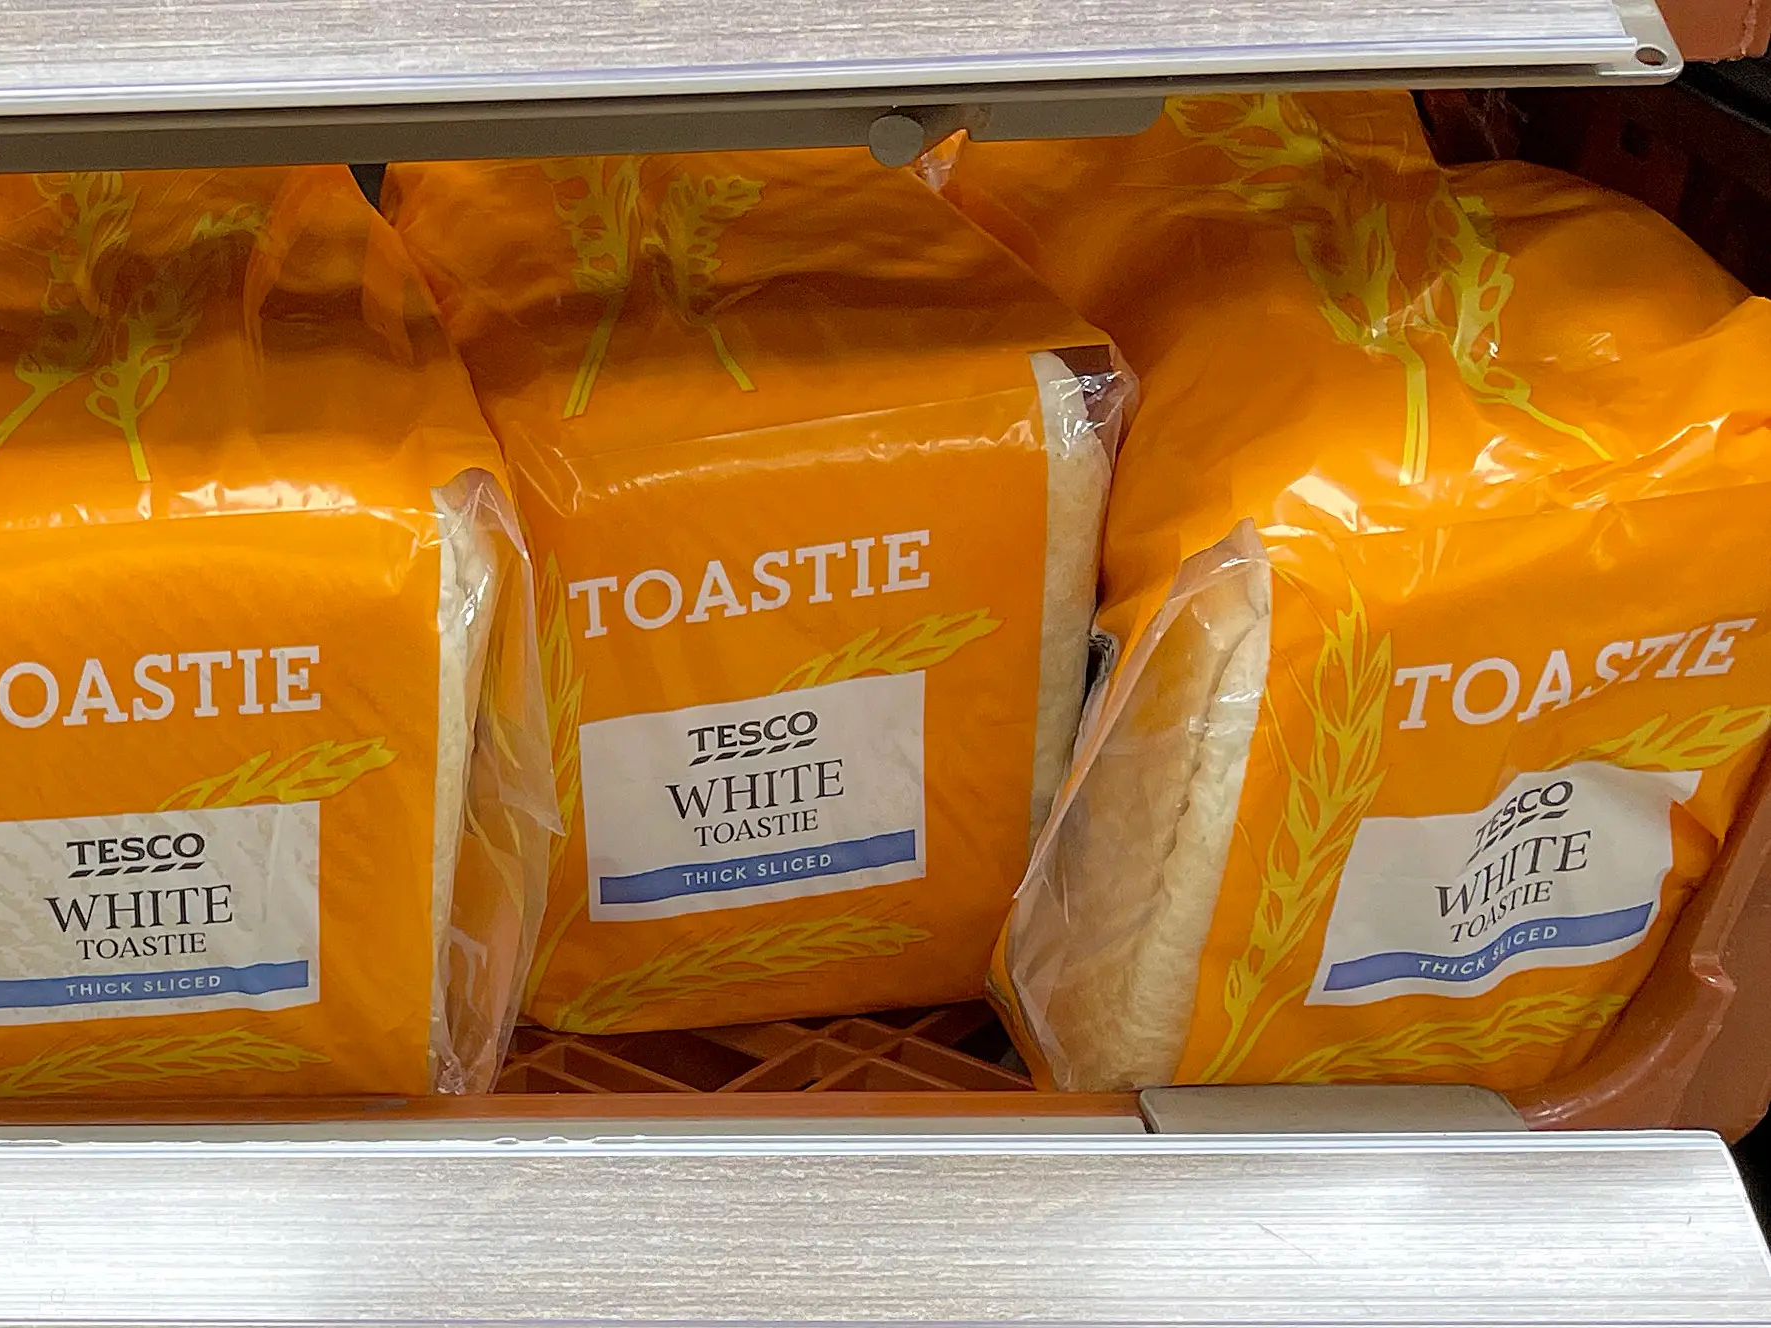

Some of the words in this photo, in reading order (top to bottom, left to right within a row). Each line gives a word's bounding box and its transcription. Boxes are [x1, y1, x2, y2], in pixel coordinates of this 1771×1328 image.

[568, 529, 931, 640] TOASTIE
[1393, 617, 1758, 731] TOASTIE
[687, 709, 820, 753] TESCO
[664, 758, 845, 821] WHITE
[1476, 779, 1574, 847] TESCO
[65, 832, 206, 867] TESCO
[693, 808, 820, 848] TOASTIE
[682, 865, 749, 887] THICK
[756, 853, 833, 878] SLICED
[1434, 829, 1593, 918] WHITE
[43, 884, 234, 934] WHITE
[1449, 879, 1554, 944] TOASTIE
[75, 932, 208, 961] TOASTIE
[1417, 956, 1488, 976] THICK
[1492, 925, 1559, 963] SLICED
[65, 980, 134, 998] THICK
[142, 974, 222, 993] SLICED
